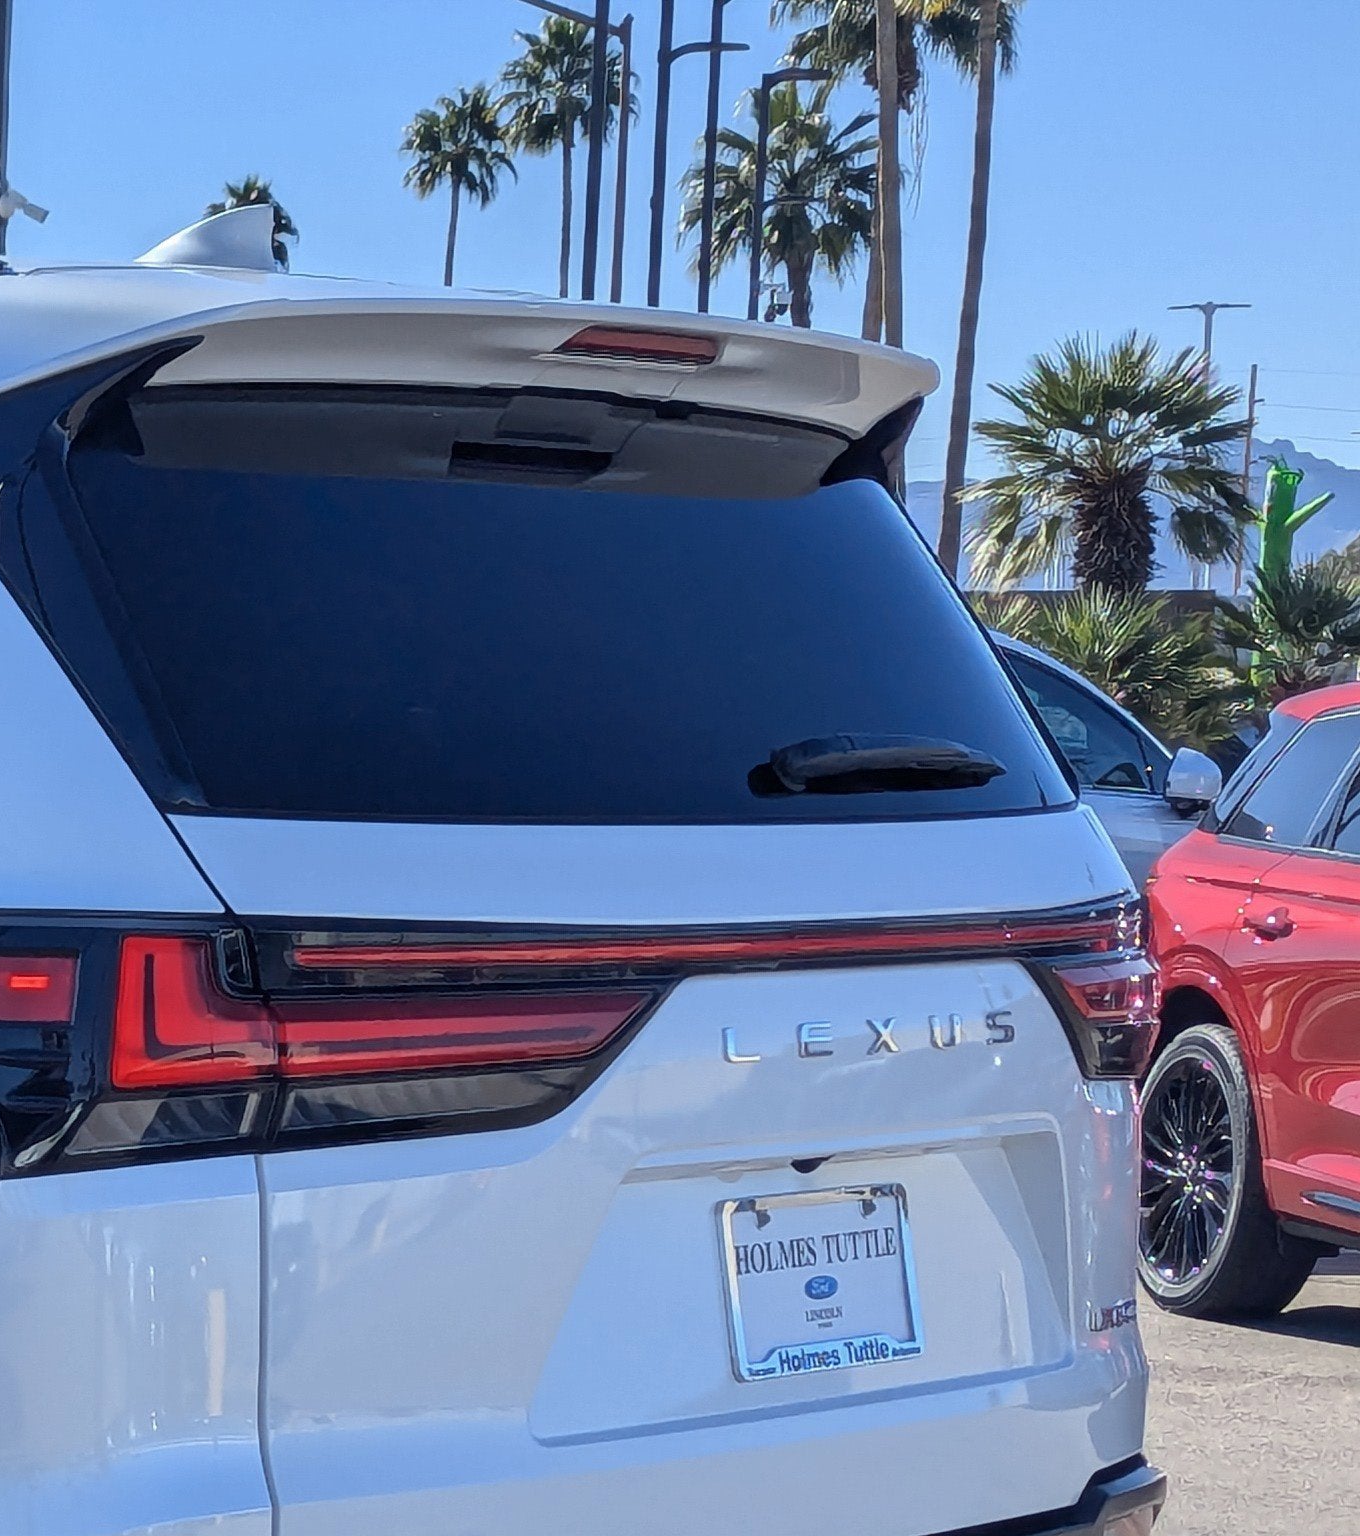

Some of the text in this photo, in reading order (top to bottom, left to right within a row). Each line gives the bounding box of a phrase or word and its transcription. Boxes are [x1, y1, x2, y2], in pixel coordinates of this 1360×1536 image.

[721, 1010, 1016, 1064] LEXUS
[734, 1226, 897, 1276] HOLMES TUTTLE
[778, 1348, 841, 1374] Holmes
[844, 1338, 890, 1363] Tuttle
